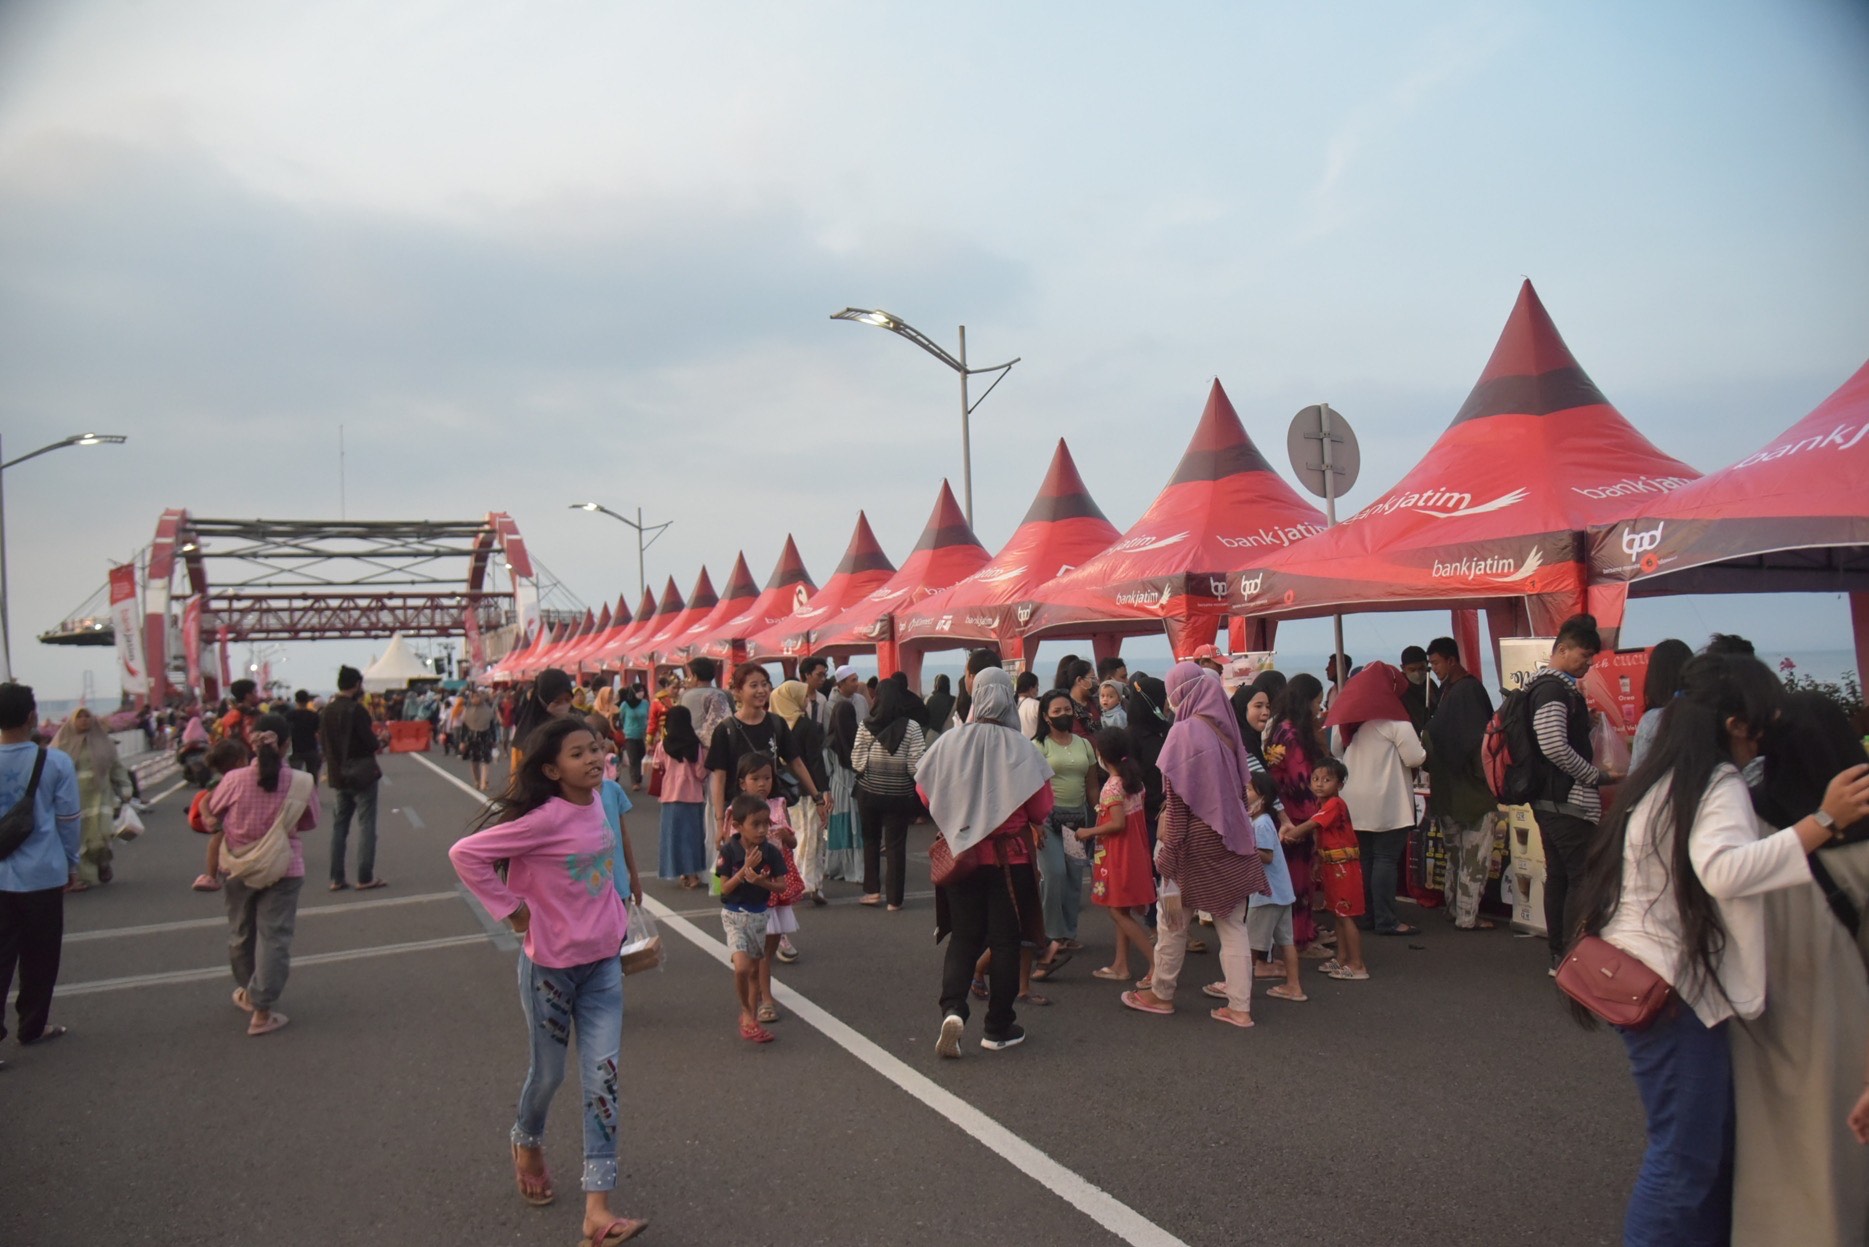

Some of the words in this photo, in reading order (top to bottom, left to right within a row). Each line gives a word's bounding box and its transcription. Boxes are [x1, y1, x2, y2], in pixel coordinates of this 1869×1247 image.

[1432, 554, 1514, 580] bankjatim
[1115, 589, 1158, 607] bankjatim
[1240, 572, 1263, 601] bpd
